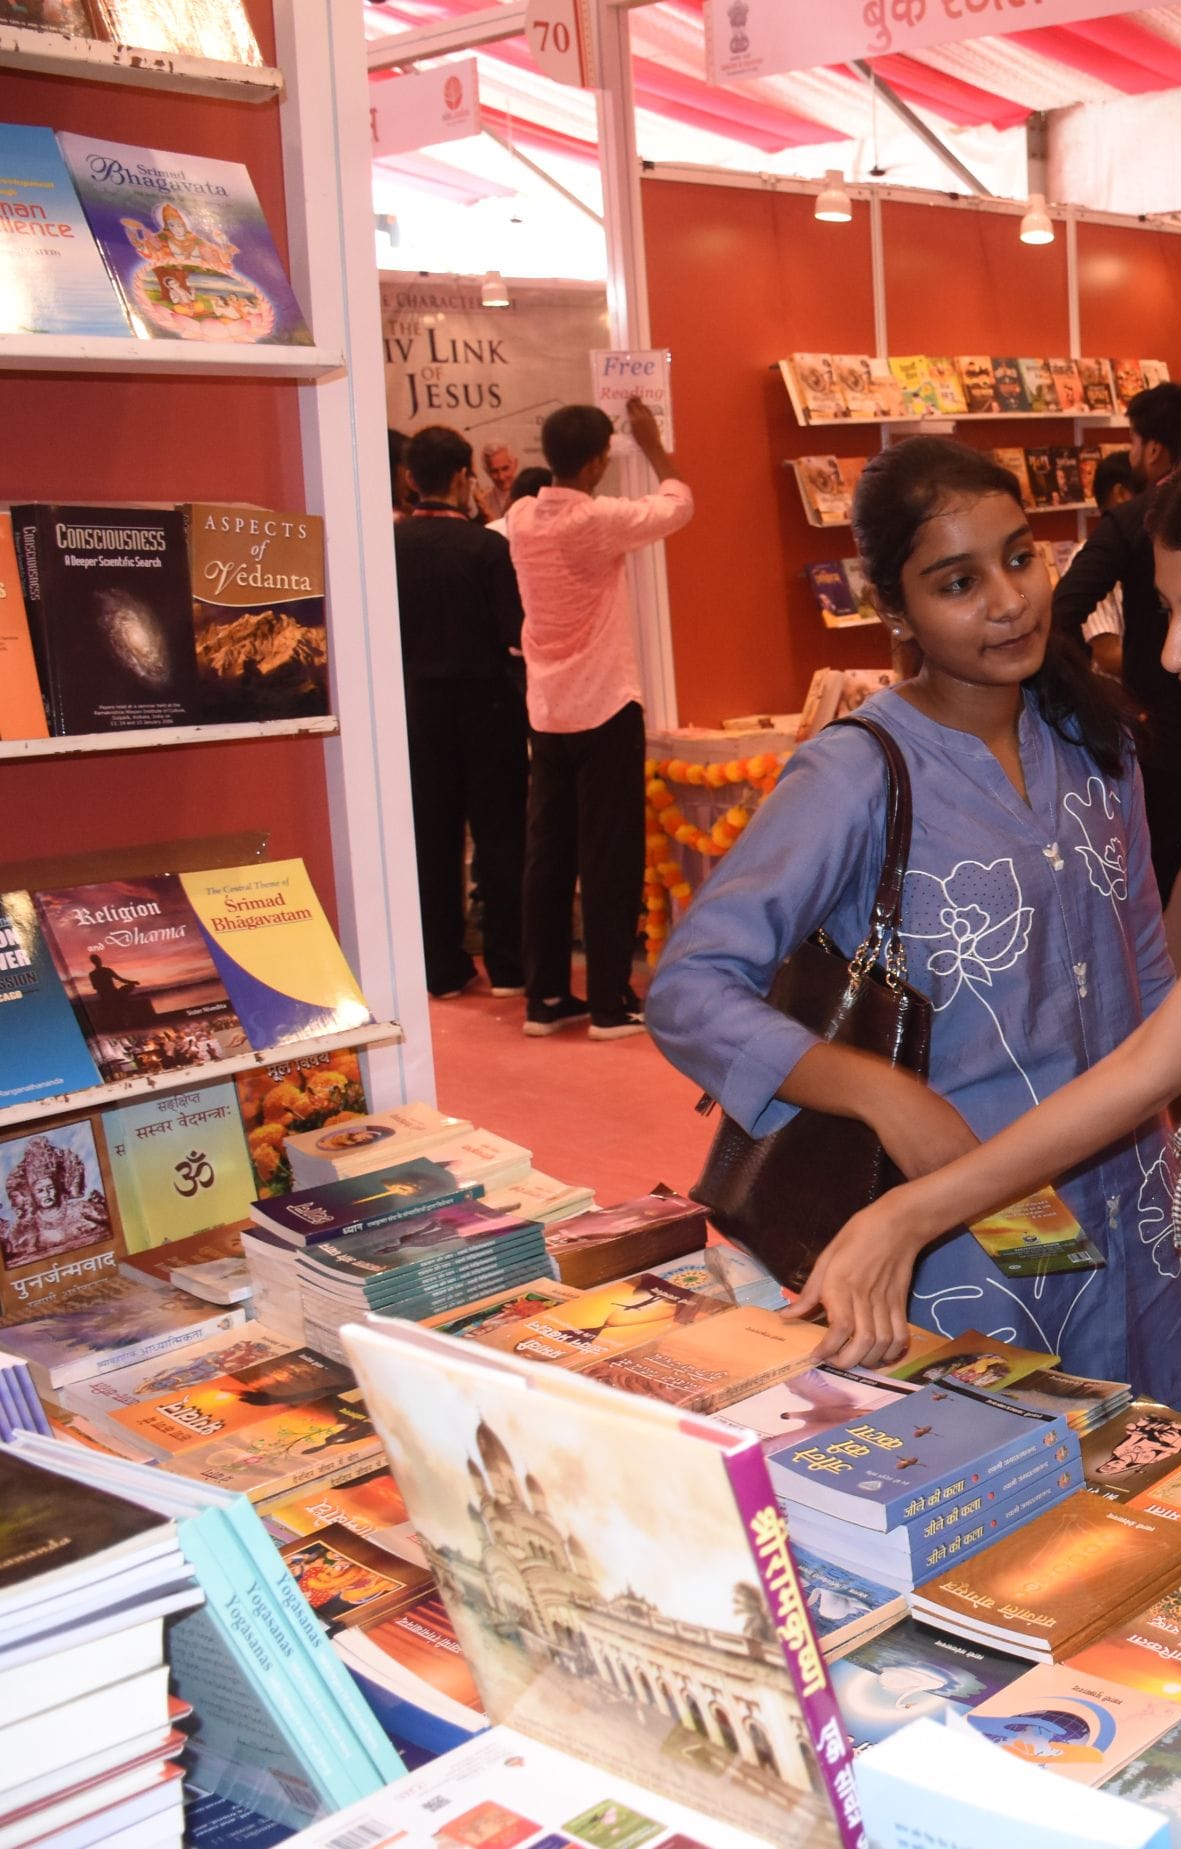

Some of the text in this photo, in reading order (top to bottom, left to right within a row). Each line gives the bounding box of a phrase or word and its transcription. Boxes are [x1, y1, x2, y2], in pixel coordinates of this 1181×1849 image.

[531, 20, 571, 55] 70
[85, 153, 228, 198] Bhagavata
[137, 164, 186, 181] Srimad
[389, 319, 423, 336] THE
[427, 329, 509, 364] LINK
[421, 367, 443, 382] OF
[602, 356, 656, 378] Free
[405, 373, 503, 419] JESUS
[600, 386, 664, 402] Reading
[205, 514, 308, 539] ASPECTS
[65, 555, 162, 570] A Deeper Scientific Search
[251, 540, 271, 561] of
[204, 560, 312, 595] Vedanta
[206, 876, 291, 896] The Central Theme of
[73, 902, 161, 927] Religion
[87, 925, 187, 953] and Dharma
[135, 1104, 232, 1141] सस्वर वेदमन्त्राः
[10, 1249, 118, 1299] पुनर्जन्मवाद
[826, 1439, 871, 1458] की
[846, 1423, 905, 1451] कला
[793, 1447, 853, 1475] जीने
[904, 1497, 926, 1519] जीने
[926, 1488, 941, 1505] की
[942, 1479, 967, 1501] कला
[1143, 1502, 1181, 1522] माता
[923, 1517, 946, 1539] जीने
[946, 1508, 960, 1525] की
[960, 1497, 983, 1519] कला
[926, 1546, 948, 1568] जीने
[948, 1536, 963, 1554] की
[963, 1525, 985, 1548] कला
[275, 1572, 324, 1650] Yogasanas
[938, 1579, 1058, 1629] पतंजलि योगसूत्र
[223, 1593, 275, 1673] Yogasanas
[244, 1580, 294, 1659] Yogasanas
[1145, 1614, 1180, 1636] राष्ट्र
[750, 1505, 827, 1698] श्रीरामकृष्ण
[815, 1716, 847, 1763] एक
